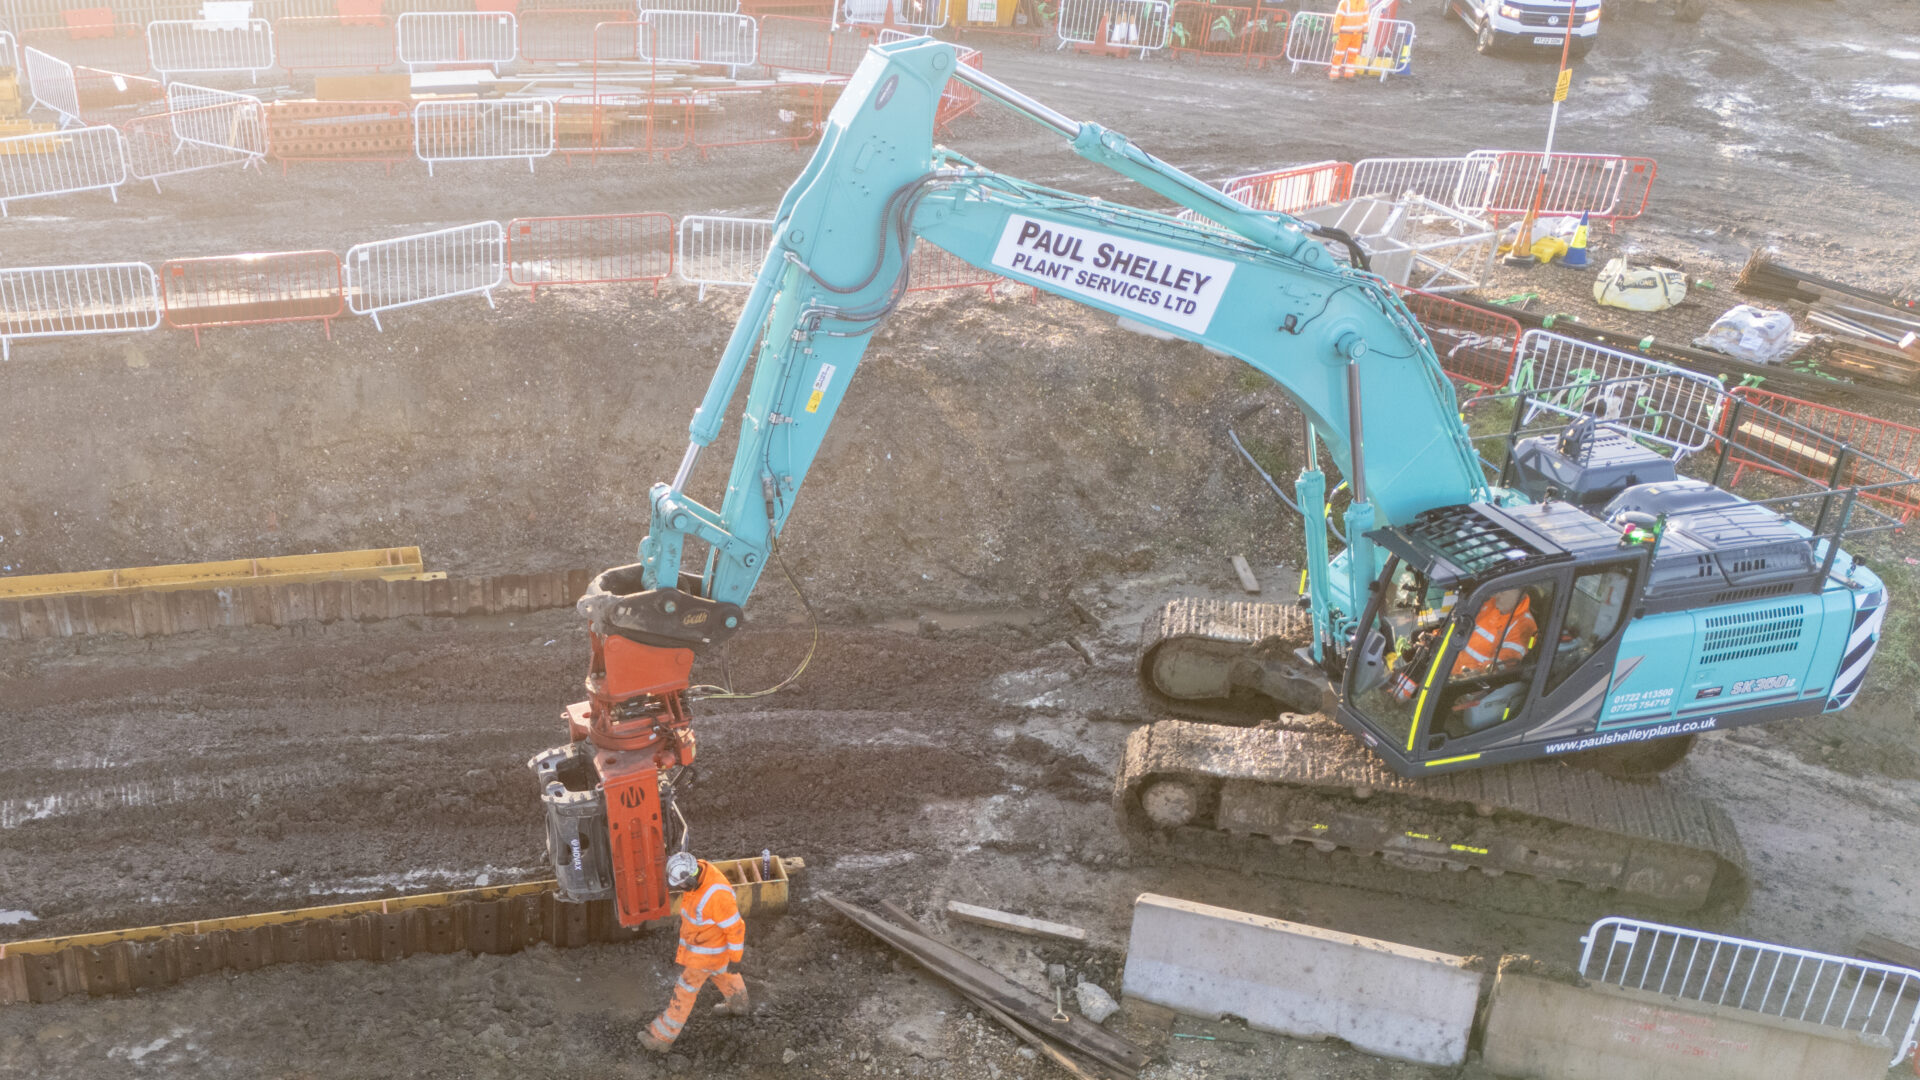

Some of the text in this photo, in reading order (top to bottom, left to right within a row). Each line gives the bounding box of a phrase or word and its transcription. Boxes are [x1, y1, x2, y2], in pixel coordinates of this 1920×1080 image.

[1017, 220, 1212, 295] PAUL SHELLEY
[1011, 252, 1197, 315] PLANT SERVICES LTD
[1614, 692, 1641, 704] 01722
[1546, 717, 1717, 753] www.paulshelleyplant.co.uk
